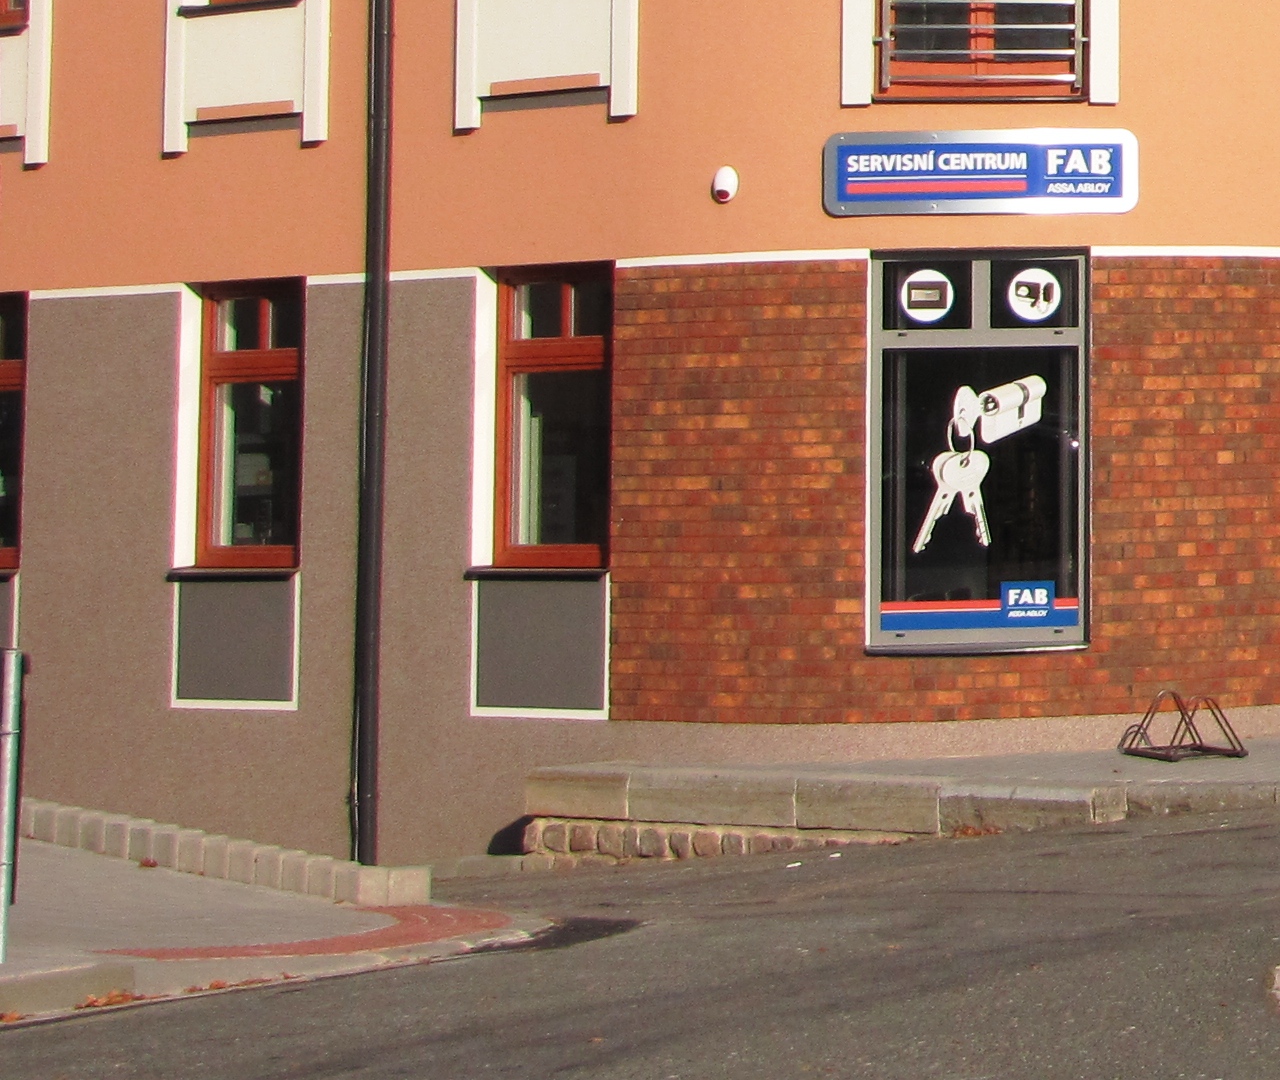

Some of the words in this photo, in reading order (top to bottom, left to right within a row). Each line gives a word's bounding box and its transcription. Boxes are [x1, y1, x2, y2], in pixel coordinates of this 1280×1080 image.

[847, 150, 935, 172] SERVISNÍ
[938, 153, 1027, 170] CENTRUM
[1047, 149, 1112, 175] FAB
[1047, 183, 1075, 193] ASSA
[1076, 183, 1111, 193] ABLOY
[1008, 588, 1048, 606] FAB
